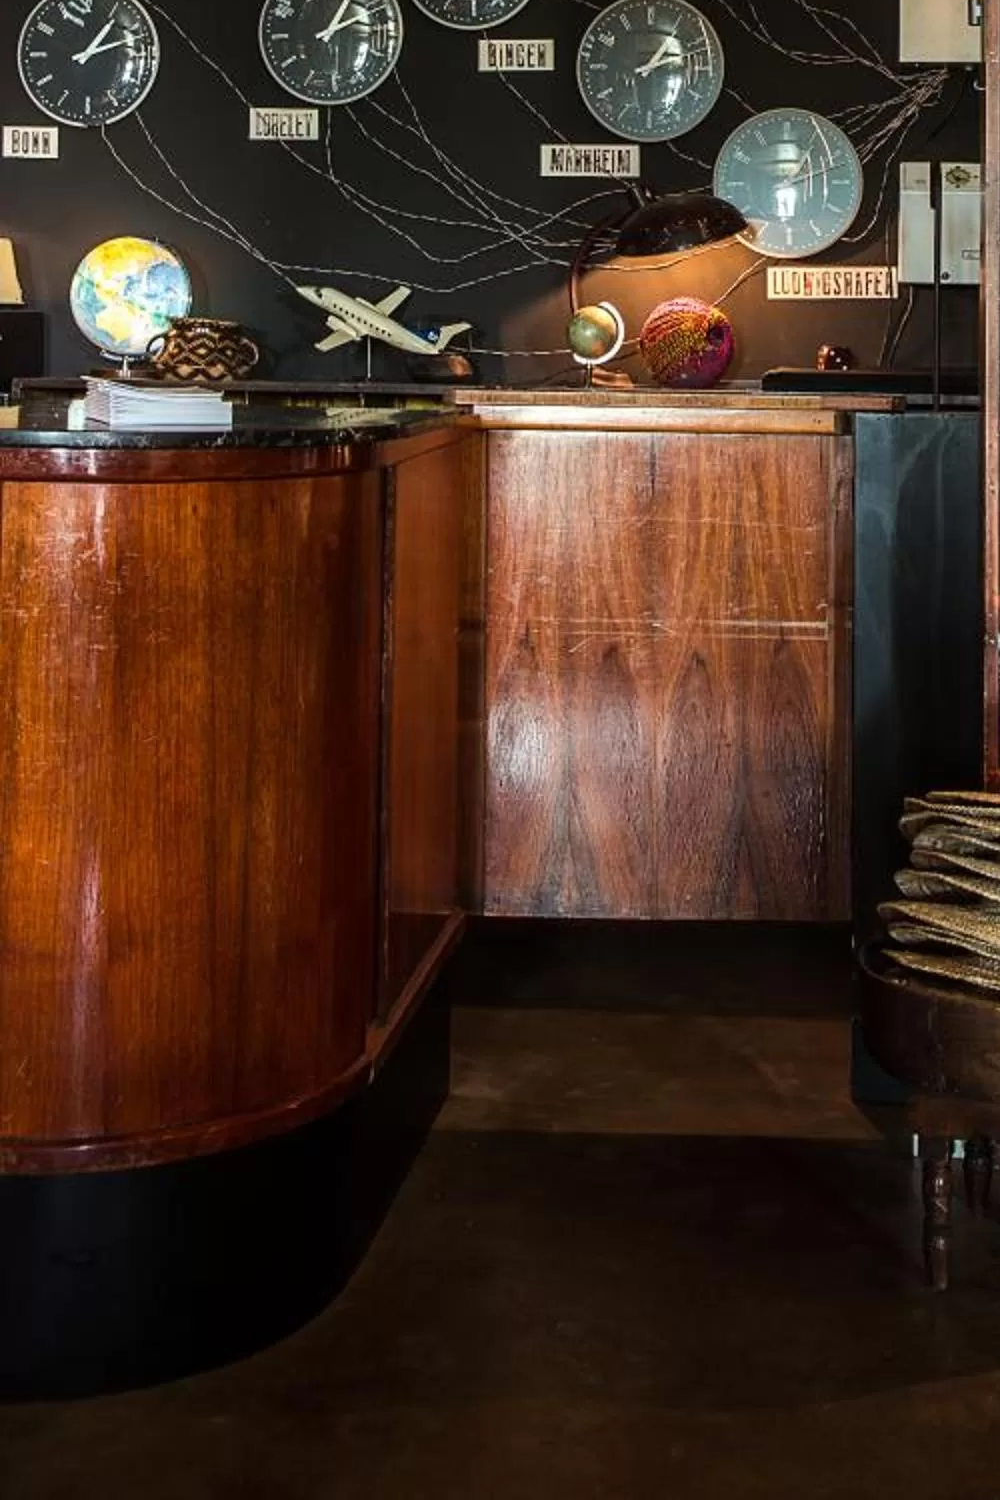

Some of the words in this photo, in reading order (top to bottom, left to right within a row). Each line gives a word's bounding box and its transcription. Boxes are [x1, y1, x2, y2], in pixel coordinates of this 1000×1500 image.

[487, 41, 546, 68] BINGEN
[12, 129, 51, 155] BONN
[550, 147, 632, 174] MANNHEIM
